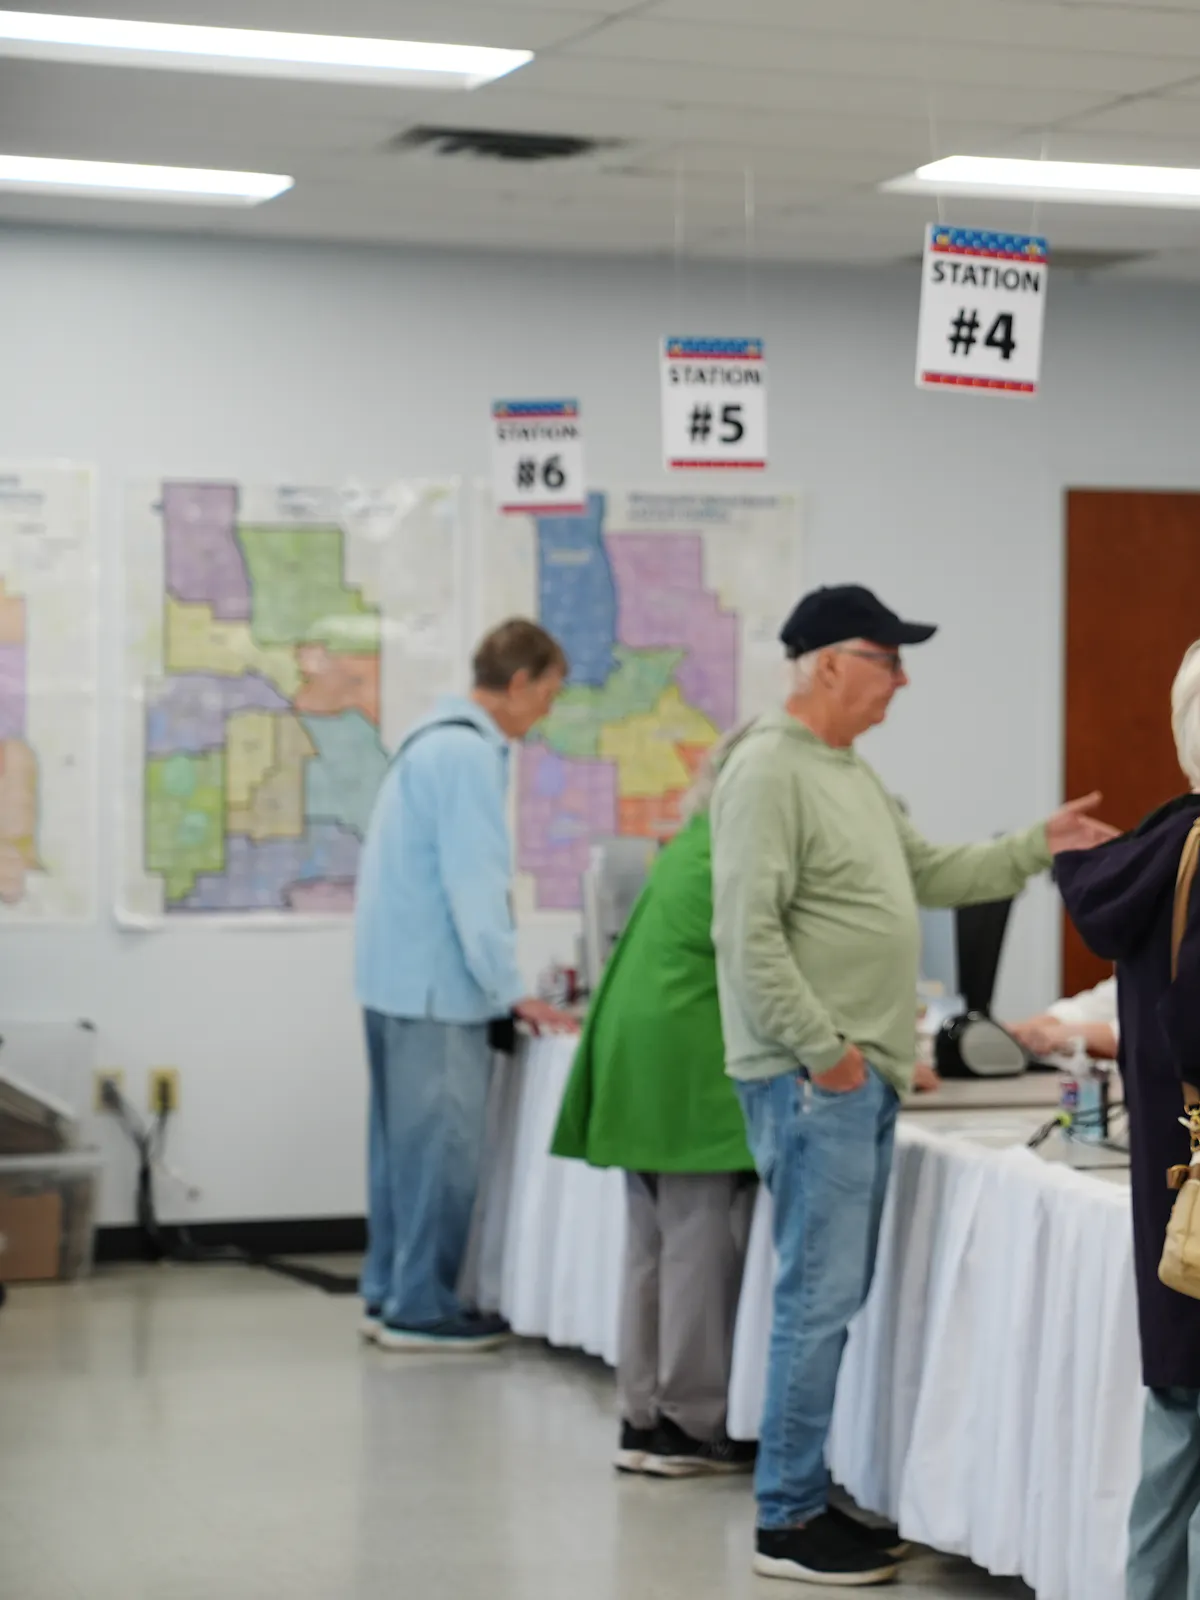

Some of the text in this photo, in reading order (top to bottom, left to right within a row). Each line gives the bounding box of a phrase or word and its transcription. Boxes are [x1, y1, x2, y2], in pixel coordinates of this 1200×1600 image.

[932, 260, 1040, 292] STATION
[948, 307, 1016, 361] #4
[668, 366, 761, 386] STATION
[690, 403, 744, 444] #5
[516, 454, 566, 489] #6
